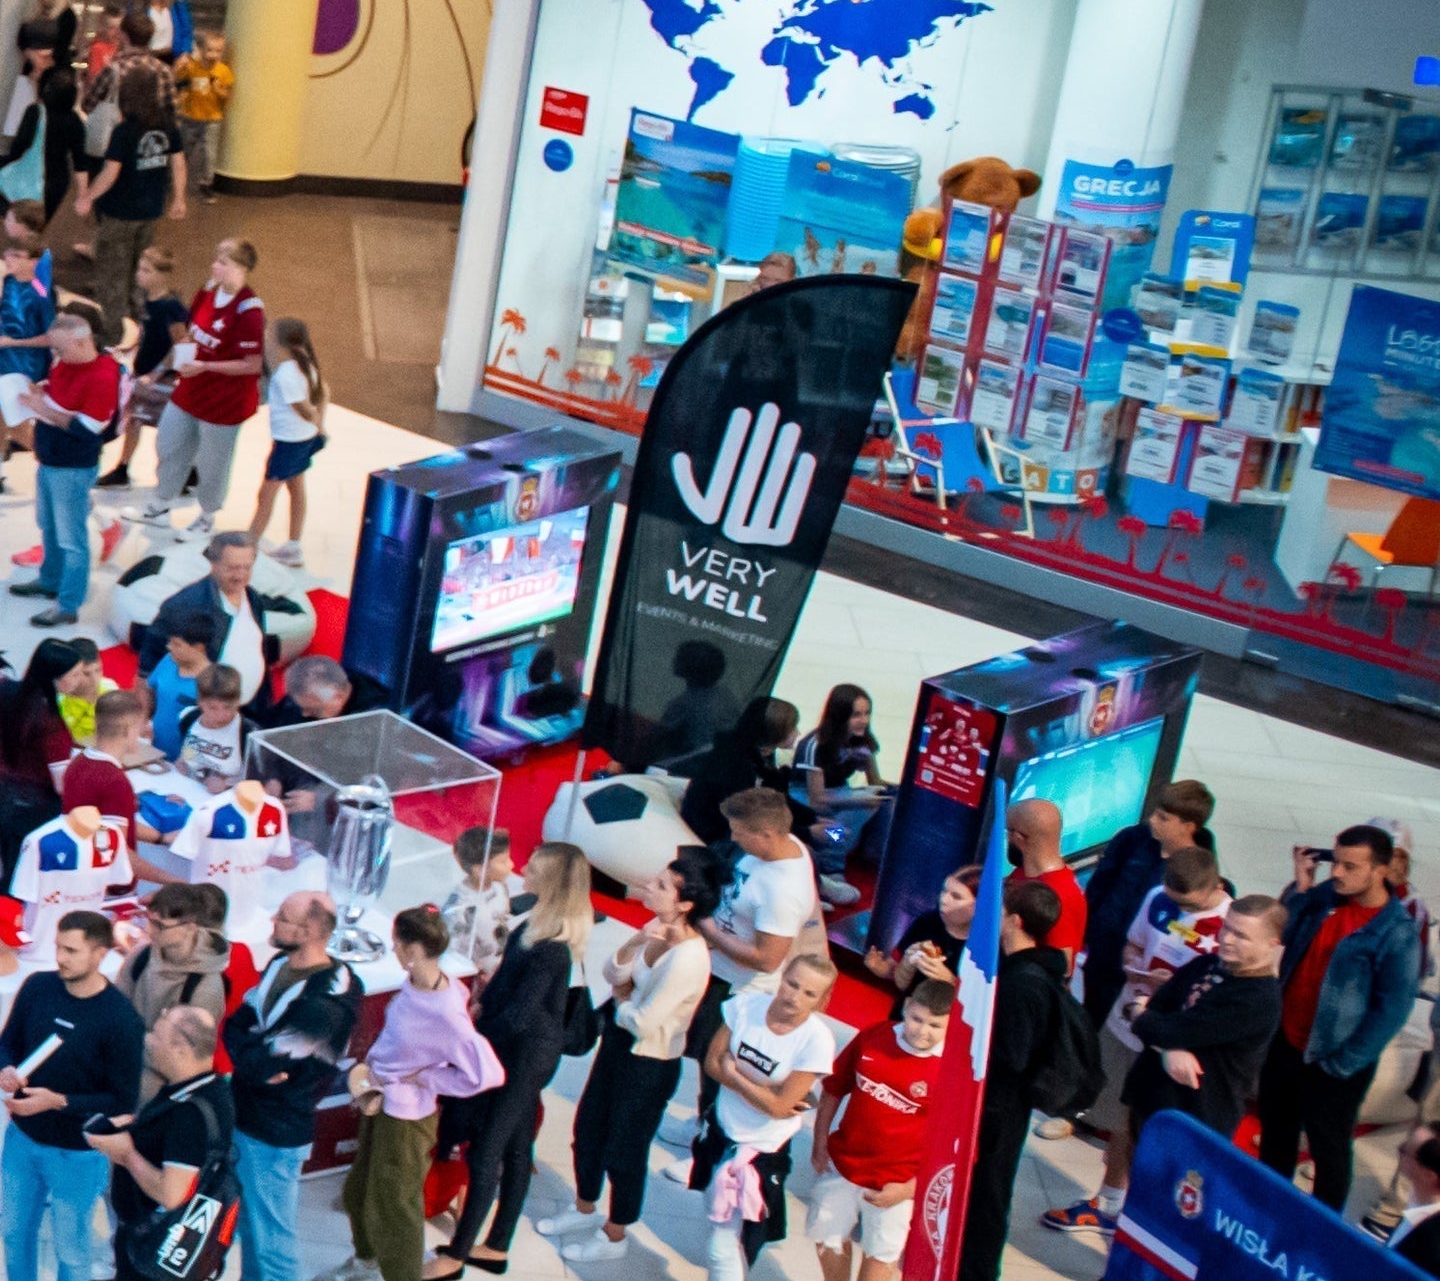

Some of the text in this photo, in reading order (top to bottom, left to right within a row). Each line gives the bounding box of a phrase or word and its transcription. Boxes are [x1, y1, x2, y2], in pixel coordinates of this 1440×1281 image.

[1072, 175, 1162, 197] GRECJA
[680, 540, 777, 588] VERY
[666, 568, 768, 623] WELL
[1213, 1209, 1291, 1280] WISŁA
